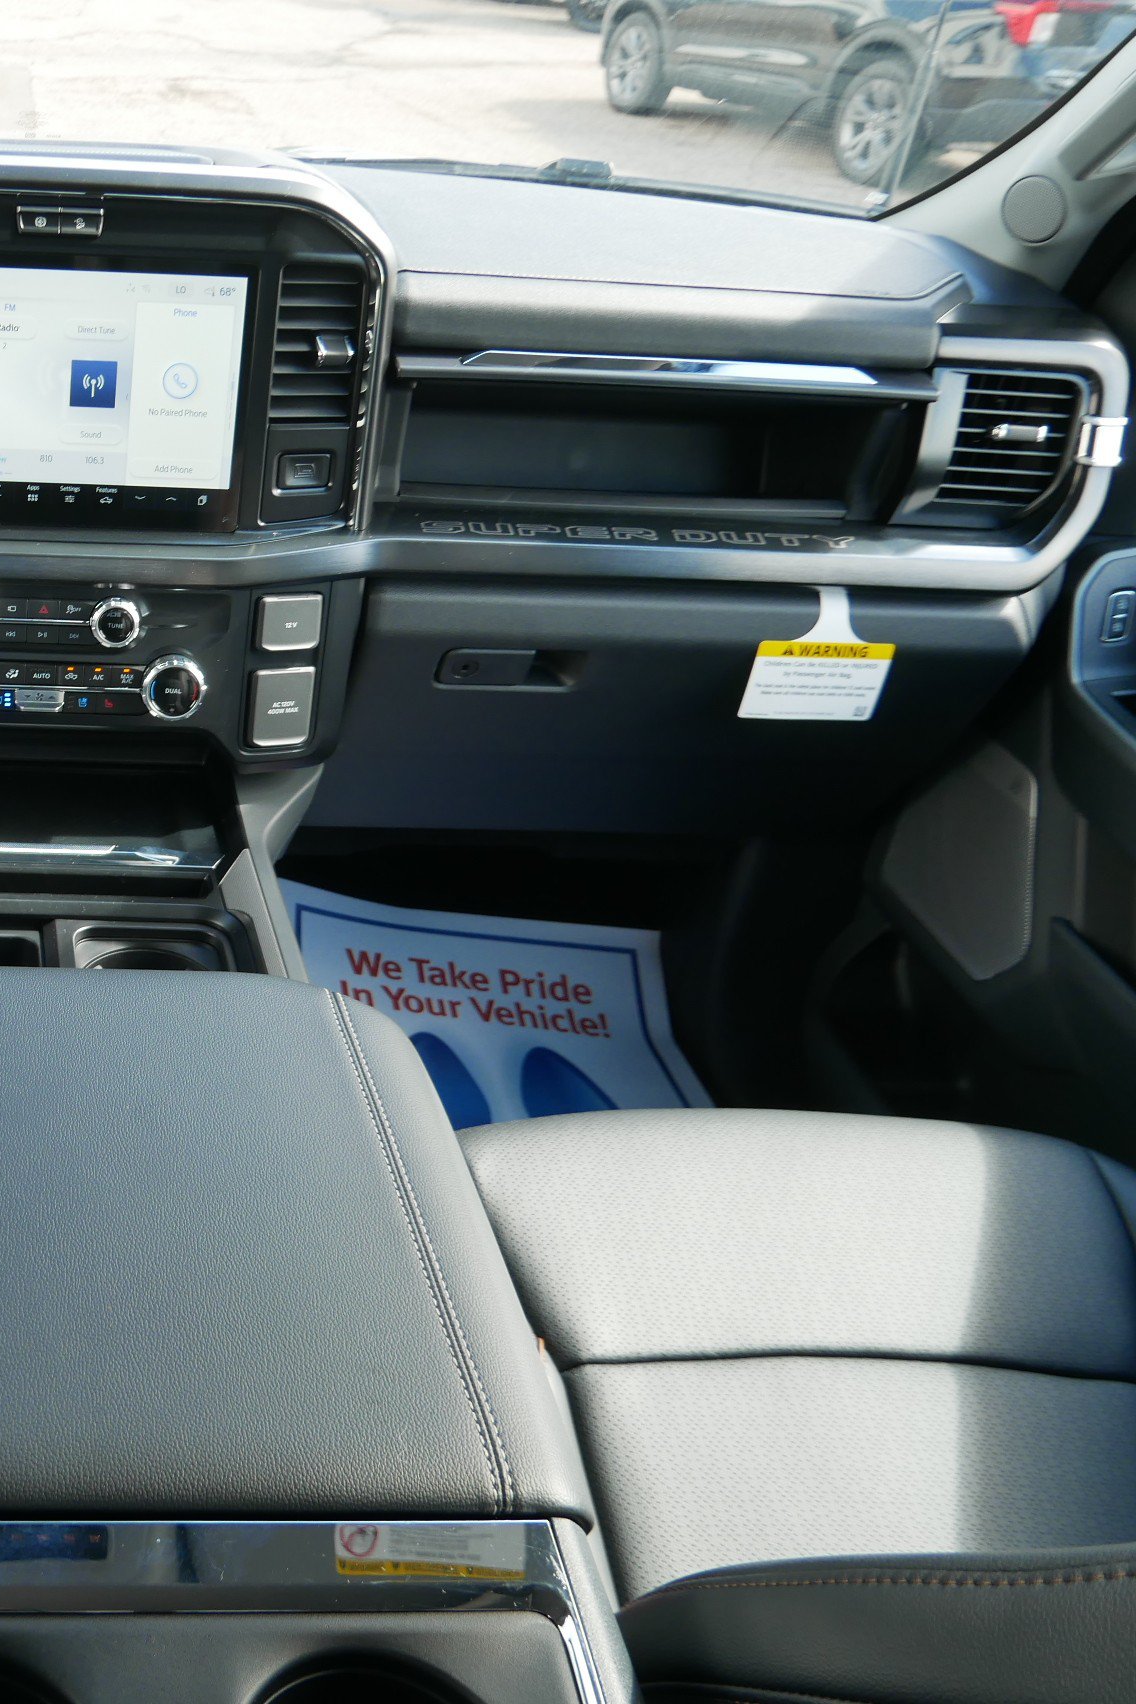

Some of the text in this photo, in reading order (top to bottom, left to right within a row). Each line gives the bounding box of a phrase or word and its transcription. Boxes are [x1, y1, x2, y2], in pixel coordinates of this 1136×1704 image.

[173, 308, 198, 318] Phone
[77, 325, 116, 335] Direct Tune
[148, 408, 208, 418] No Paired Phone
[80, 430, 102, 439] Sound
[39, 454, 53, 463] 810
[84, 456, 105, 465] 106.3
[154, 465, 193, 474] Add Phone
[26, 484, 40, 492] Apps
[59, 485, 81, 494] Settings
[95, 486, 118, 494] Features
[420, 519, 856, 549] SUPER DUTY
[799, 645, 870, 658] WARNING
[33, 672, 51, 680] AUTO
[92, 673, 104, 681] A/C
[165, 687, 182, 695] DUAL
[285, 706, 299, 714] MAX
[345, 947, 593, 1006] We Take Pride
[381, 984, 462, 1018] Your
[469, 997, 612, 1039] Vehicle!
